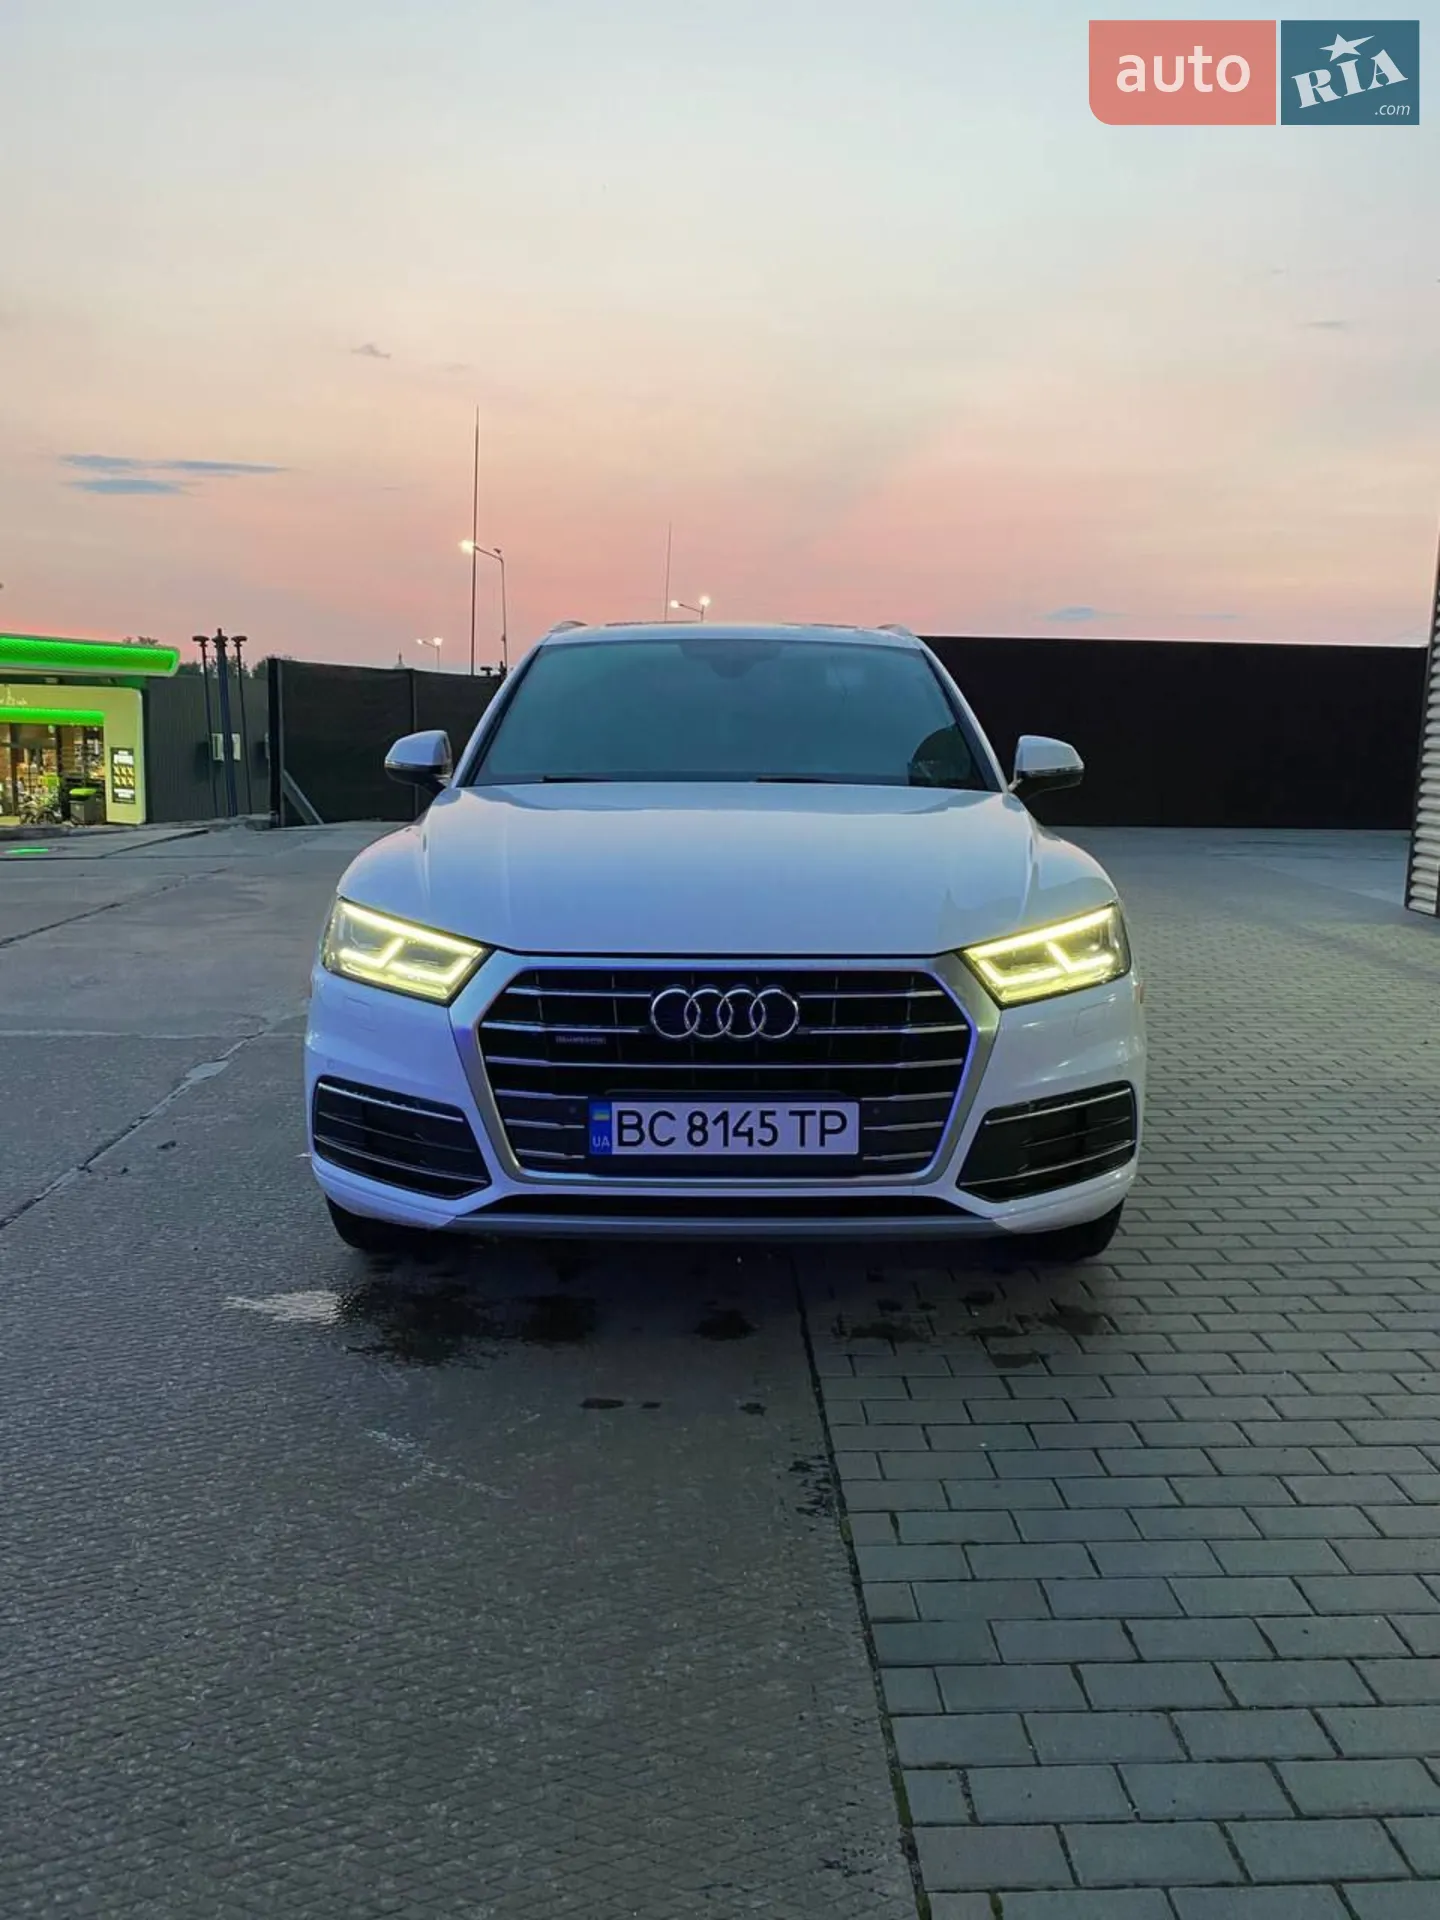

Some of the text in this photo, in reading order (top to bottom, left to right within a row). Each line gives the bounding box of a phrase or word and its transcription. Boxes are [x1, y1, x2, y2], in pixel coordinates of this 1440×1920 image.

[616, 1109, 848, 1147] BC 8145 TP
[592, 1136, 610, 1148] UA
